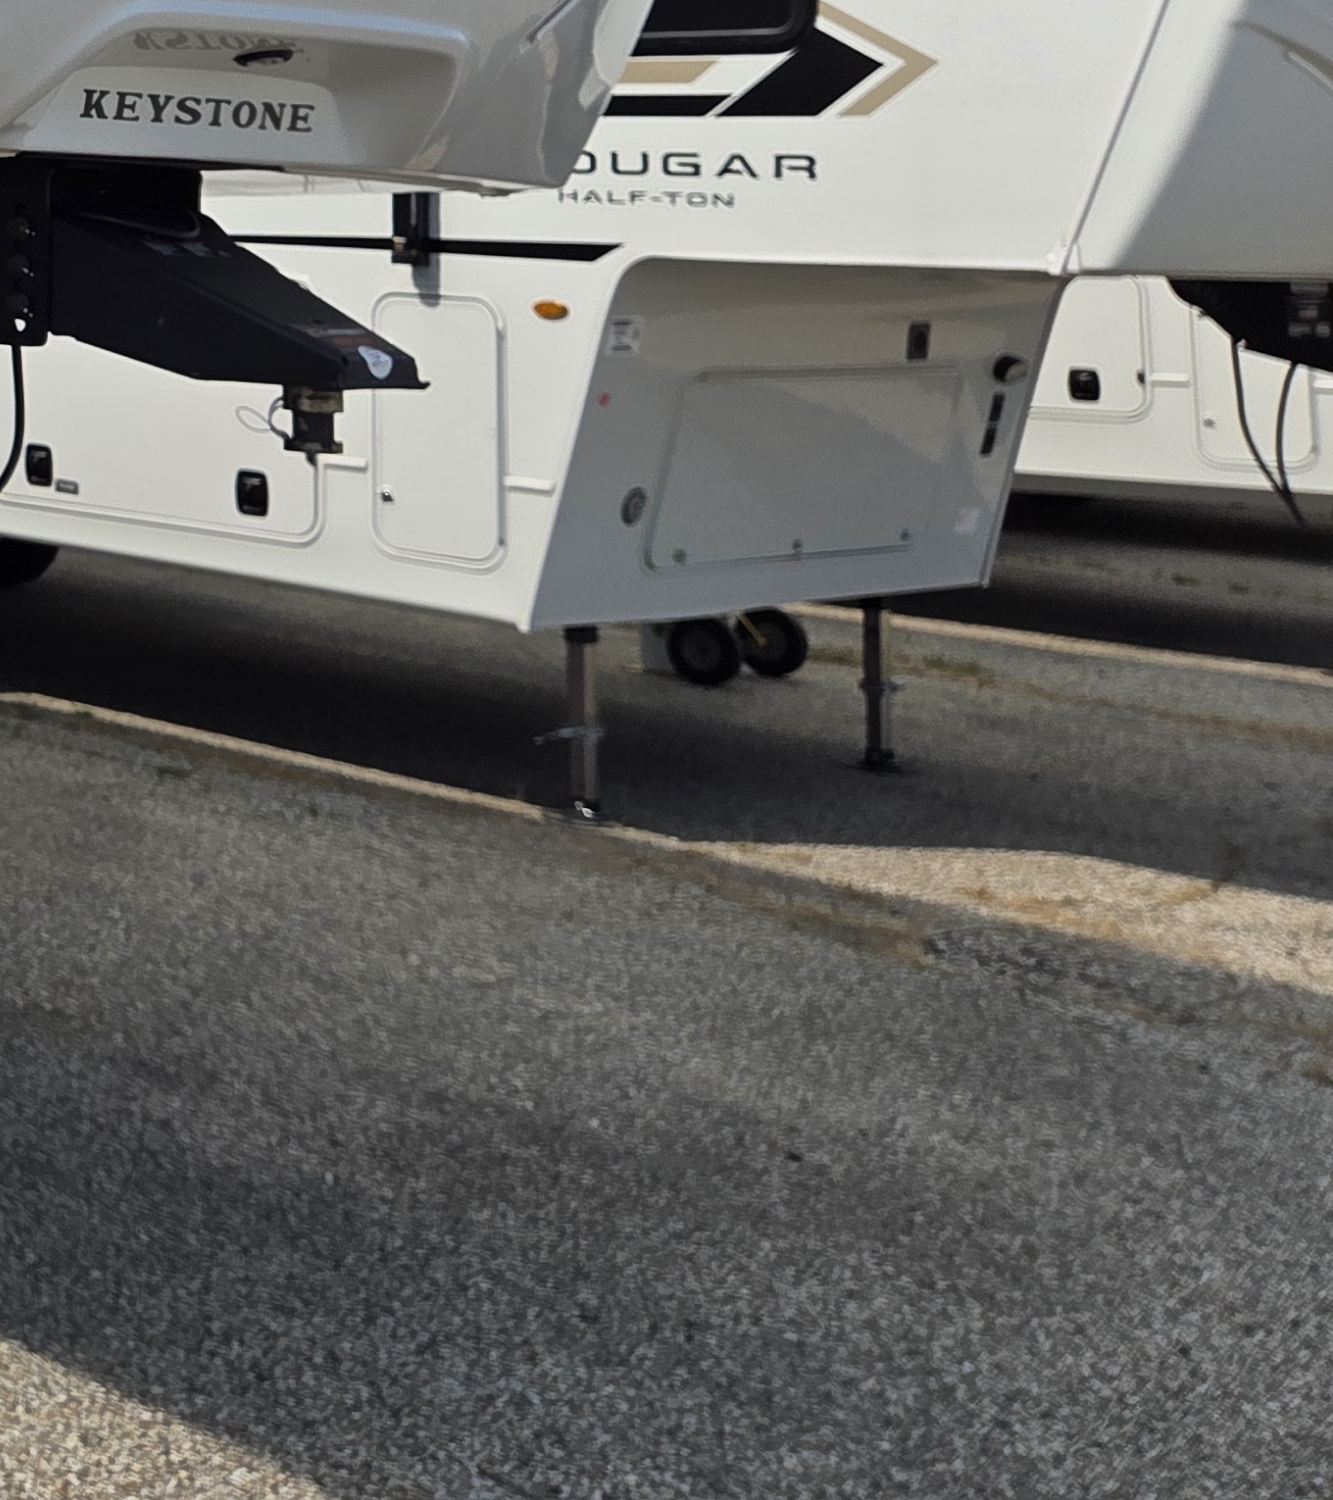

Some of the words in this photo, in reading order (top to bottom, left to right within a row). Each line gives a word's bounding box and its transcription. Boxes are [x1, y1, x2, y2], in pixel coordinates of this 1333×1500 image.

[79, 88, 316, 133] KEYSTONE
[572, 149, 818, 180] OUGAR
[558, 188, 735, 208] HALF-TON
